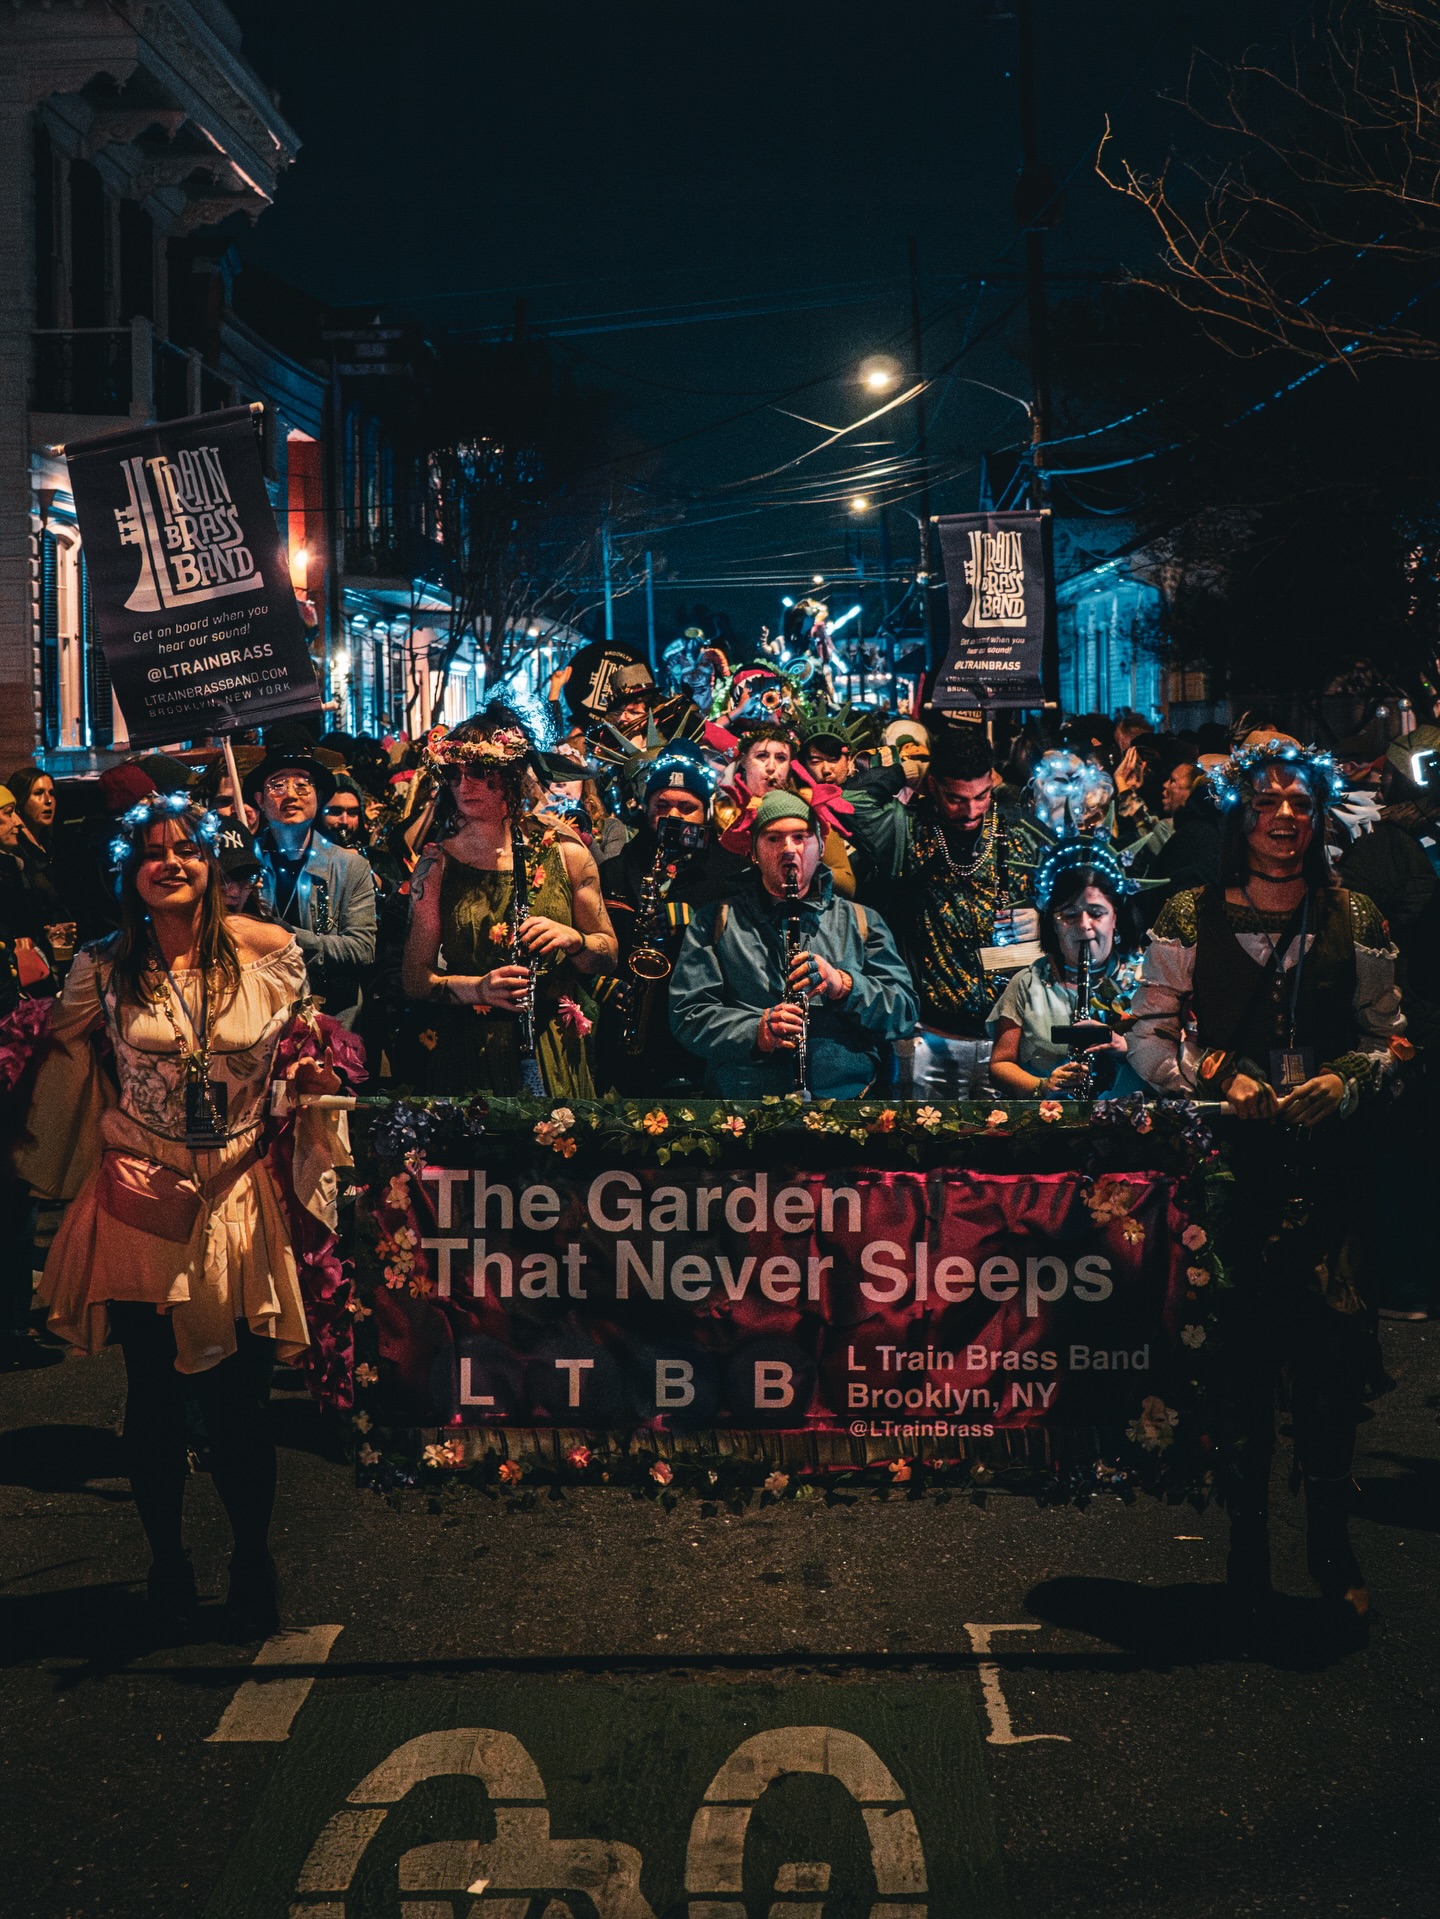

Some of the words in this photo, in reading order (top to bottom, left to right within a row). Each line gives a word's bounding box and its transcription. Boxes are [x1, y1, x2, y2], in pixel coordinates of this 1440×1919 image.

[146, 446, 232, 524] TRAIN
[164, 504, 244, 551] BRASS
[170, 543, 255, 591] BAND
[982, 531, 1023, 576] TRAIN
[981, 570, 1024, 598] BRASS
[133, 630, 153, 643] Get
[157, 626, 172, 638] on
[175, 616, 209, 634] board
[213, 609, 244, 625] when
[248, 605, 269, 618] you
[981, 593, 1025, 618] BAND
[158, 639, 185, 654] hear
[189, 635, 208, 648] our
[211, 623, 250, 642] sound!
[1011, 637, 1025, 645] you
[147, 643, 274, 683] @LTRAINBRASS
[954, 660, 1021, 671] @LTRAINBRASS
[144, 666, 288, 707] LTRAINBRASSBAND.COM
[226, 690, 253, 704] NEW
[258, 682, 291, 696] YORK
[421, 1169, 561, 1232] The
[587, 1169, 862, 1233] Garden
[421, 1237, 588, 1300] That
[615, 1239, 834, 1302] Never
[859, 1239, 1114, 1318] Sleeps
[847, 1345, 866, 1371] L
[875, 1344, 955, 1371] Train
[966, 1344, 1058, 1371] Brass
[1069, 1343, 1150, 1371] Band
[460, 1357, 495, 1406] L
[555, 1358, 595, 1407] T
[655, 1359, 696, 1408] B
[754, 1360, 796, 1409] B
[847, 1382, 1000, 1415] Brooklyn,
[1012, 1381, 1057, 1408] NY
[850, 1420, 995, 1438] @LTrainBrass
